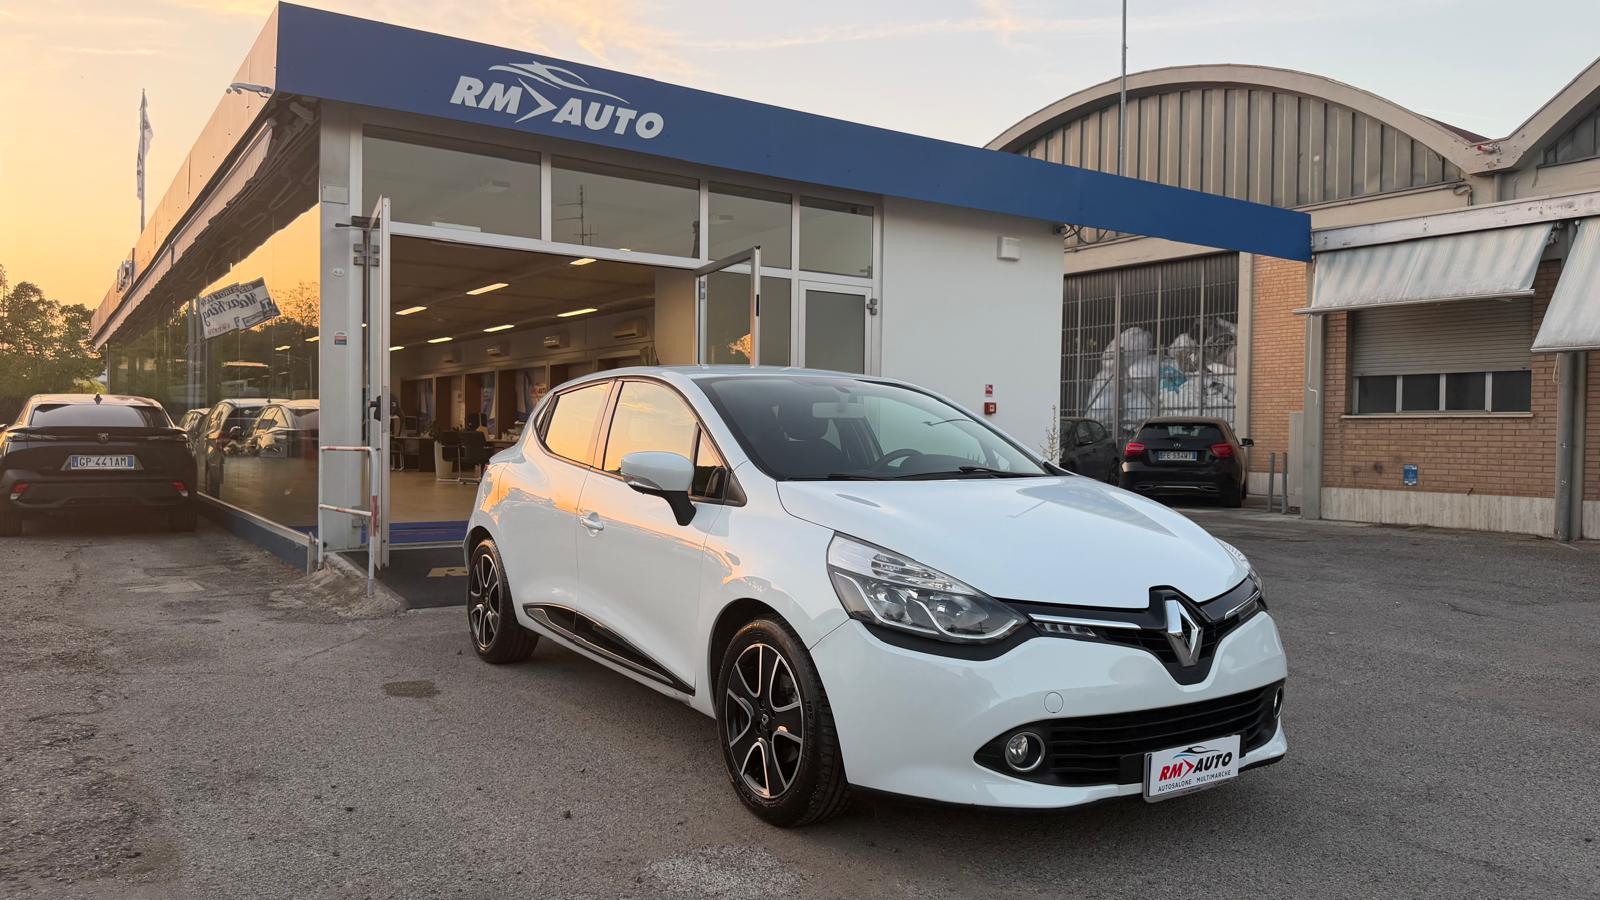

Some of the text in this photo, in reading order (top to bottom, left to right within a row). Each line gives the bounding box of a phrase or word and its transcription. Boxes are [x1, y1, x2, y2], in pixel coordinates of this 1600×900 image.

[552, 97, 665, 139] AUTO
[1192, 752, 1233, 774] AUTO
[1158, 779, 1192, 792] AUTOSALONE
[1196, 770, 1231, 782] MULTIMARCHE
